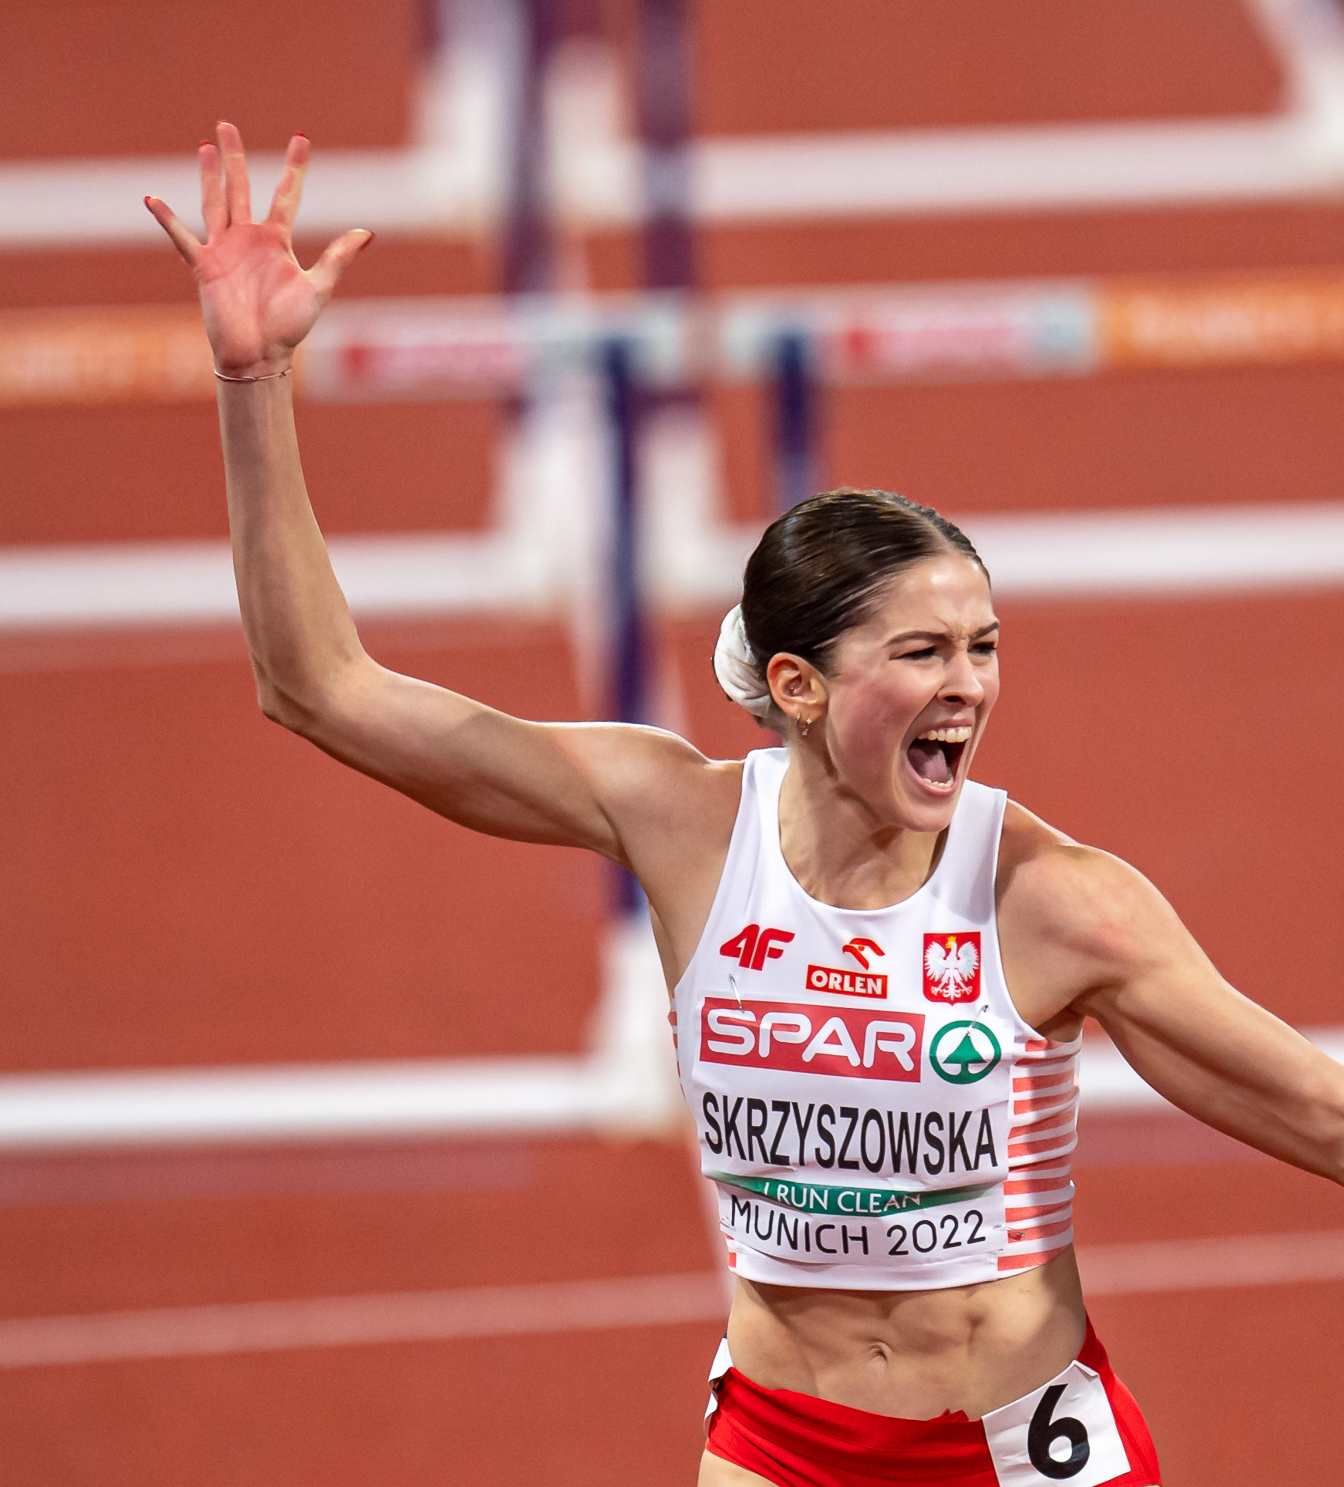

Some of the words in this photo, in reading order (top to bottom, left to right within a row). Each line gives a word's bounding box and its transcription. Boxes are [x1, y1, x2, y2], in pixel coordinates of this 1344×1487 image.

[719, 924, 795, 971] 4F
[811, 970, 882, 995] ORLEN
[707, 1009, 916, 1071] SPAR
[702, 1091, 998, 1175] SKRZYSZOWSKA
[731, 1195, 869, 1255] MUNICH
[887, 1210, 986, 1256] 2022
[763, 1181, 770, 1196] I
[777, 1183, 829, 1209] RUN
[837, 1191, 922, 1213] CLEAN
[1027, 1383, 1090, 1480] 6
